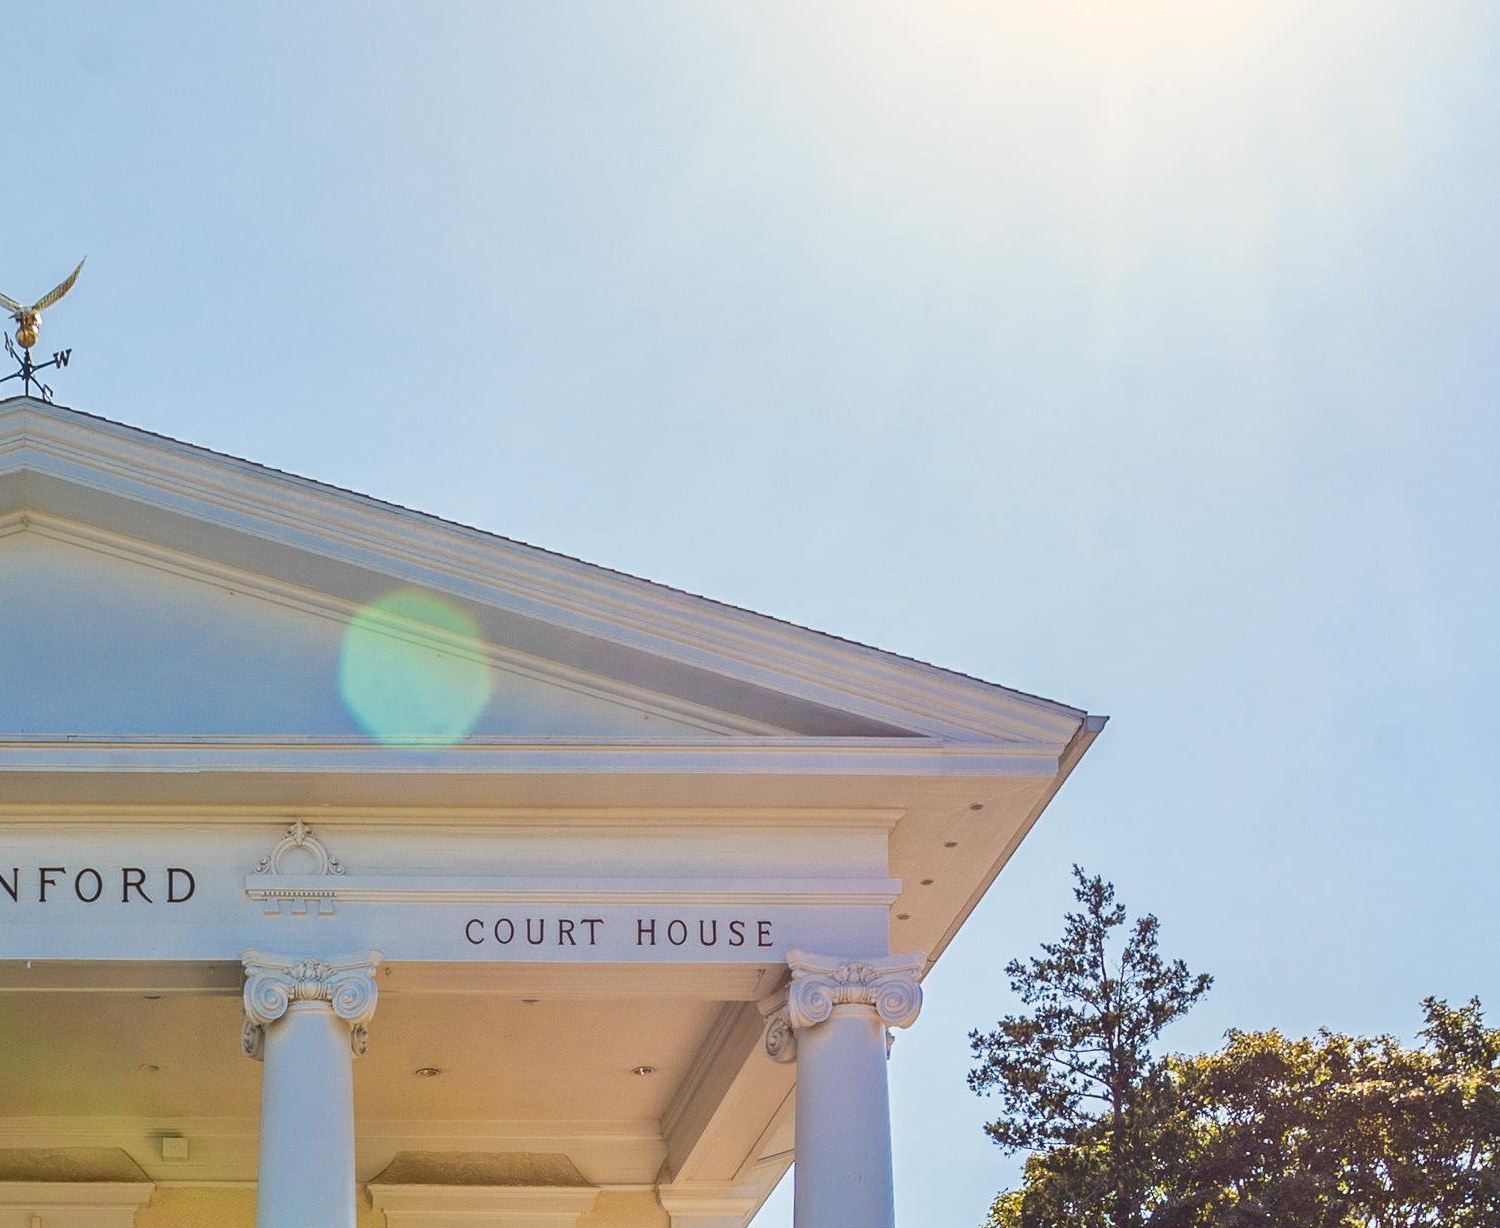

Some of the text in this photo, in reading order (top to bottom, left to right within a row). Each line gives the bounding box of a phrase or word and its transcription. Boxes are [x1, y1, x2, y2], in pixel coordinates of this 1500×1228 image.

[53, 348, 72, 369] W
[465, 918, 774, 947] COURT HOUSE
